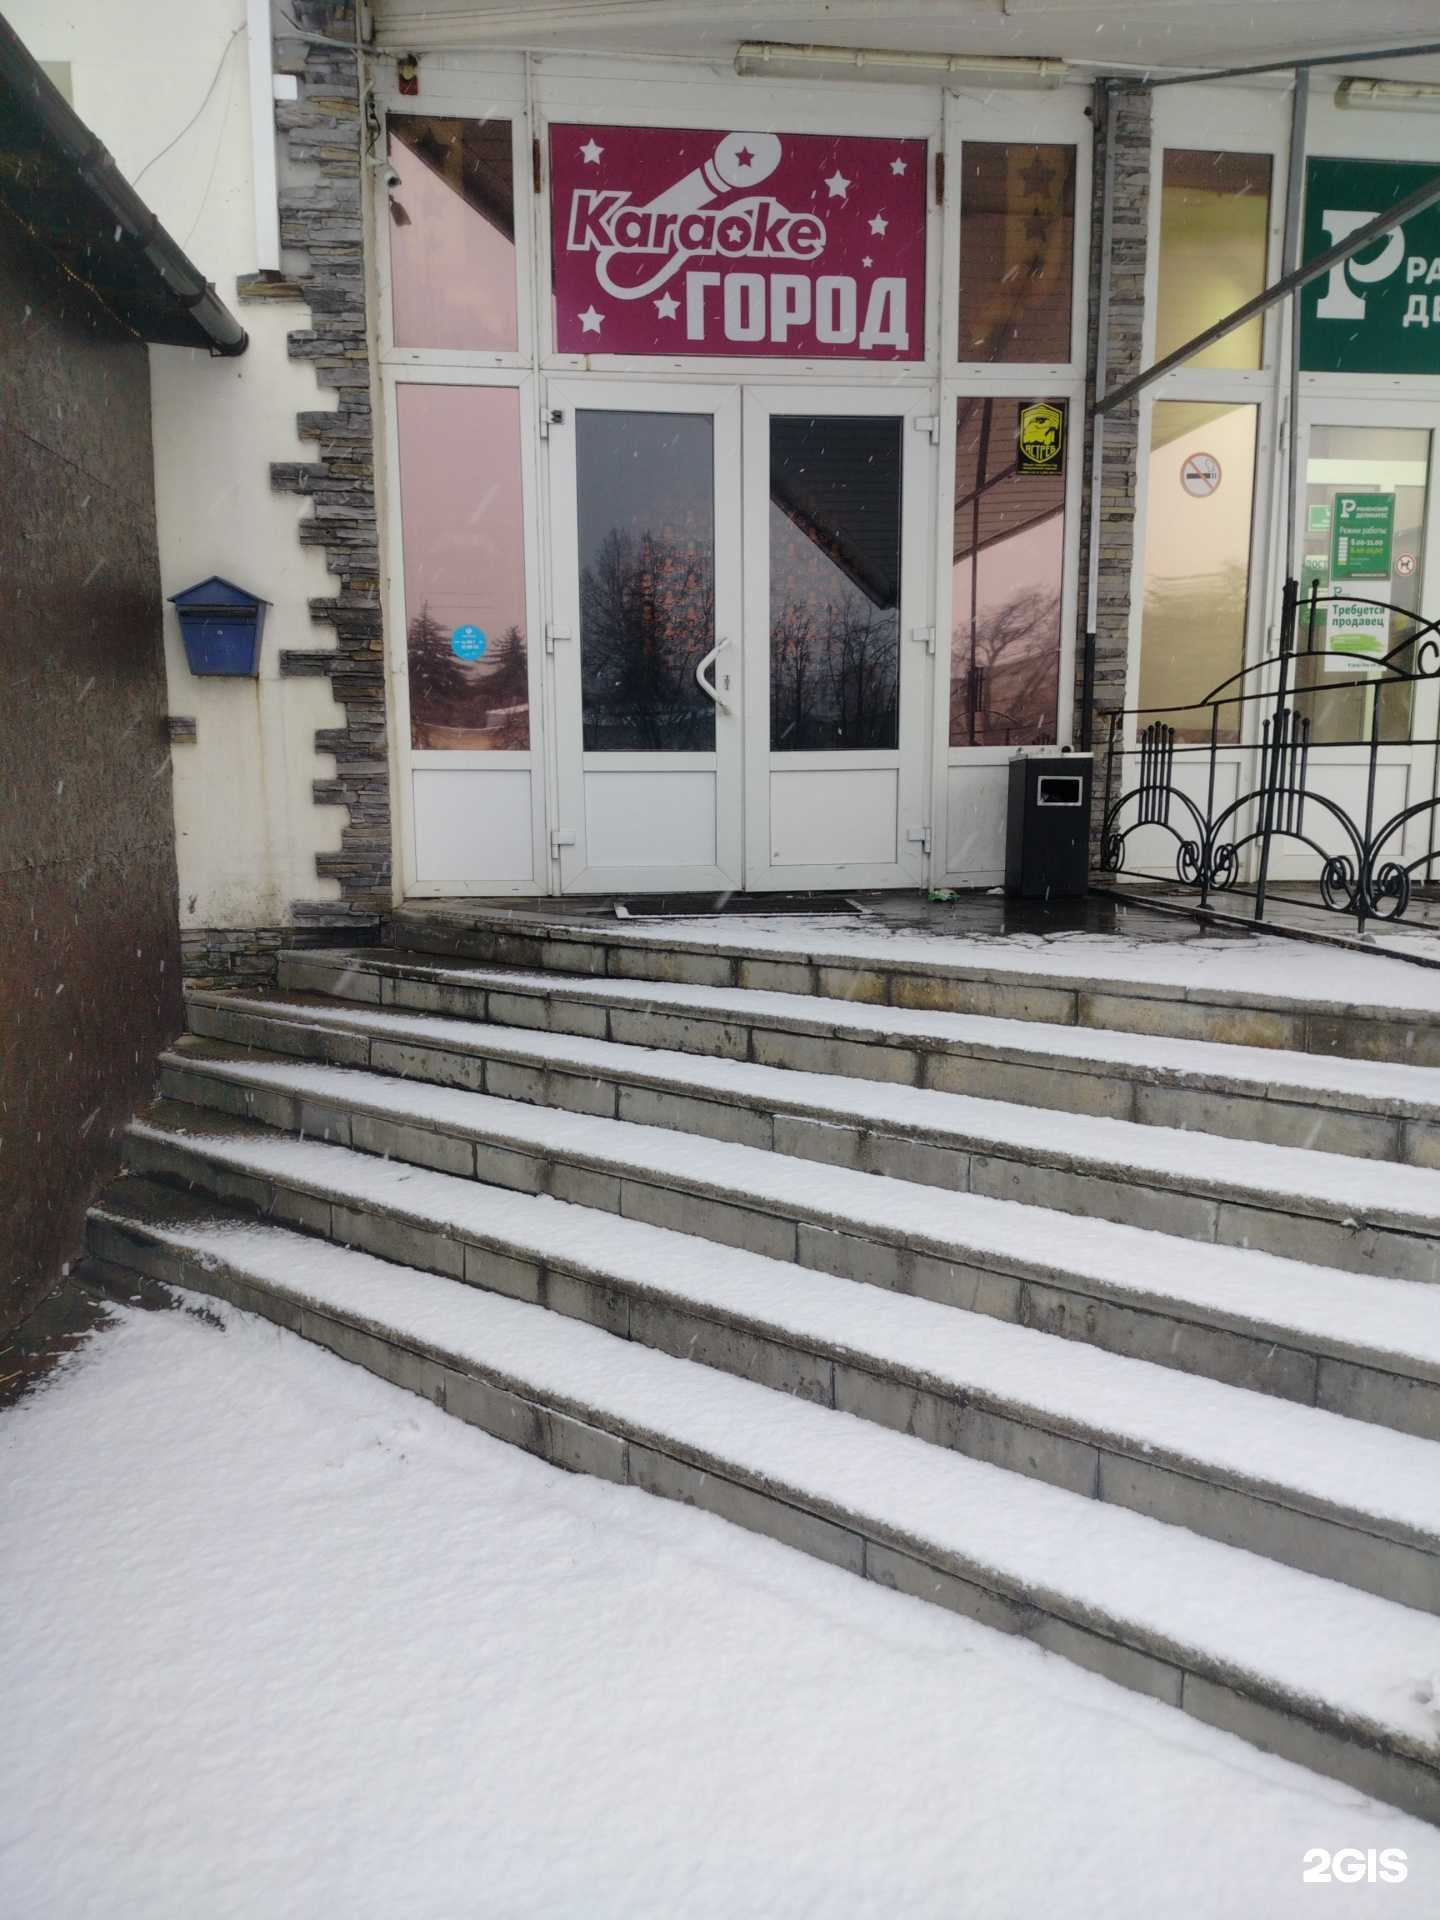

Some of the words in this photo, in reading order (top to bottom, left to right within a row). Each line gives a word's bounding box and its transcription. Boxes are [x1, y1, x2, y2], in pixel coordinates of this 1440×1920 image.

[567, 190, 826, 260] Karaoke
[686, 271, 909, 351] ГОРОД
[1332, 604, 1385, 617] Требуется
[1332, 618, 1384, 628] продавец
